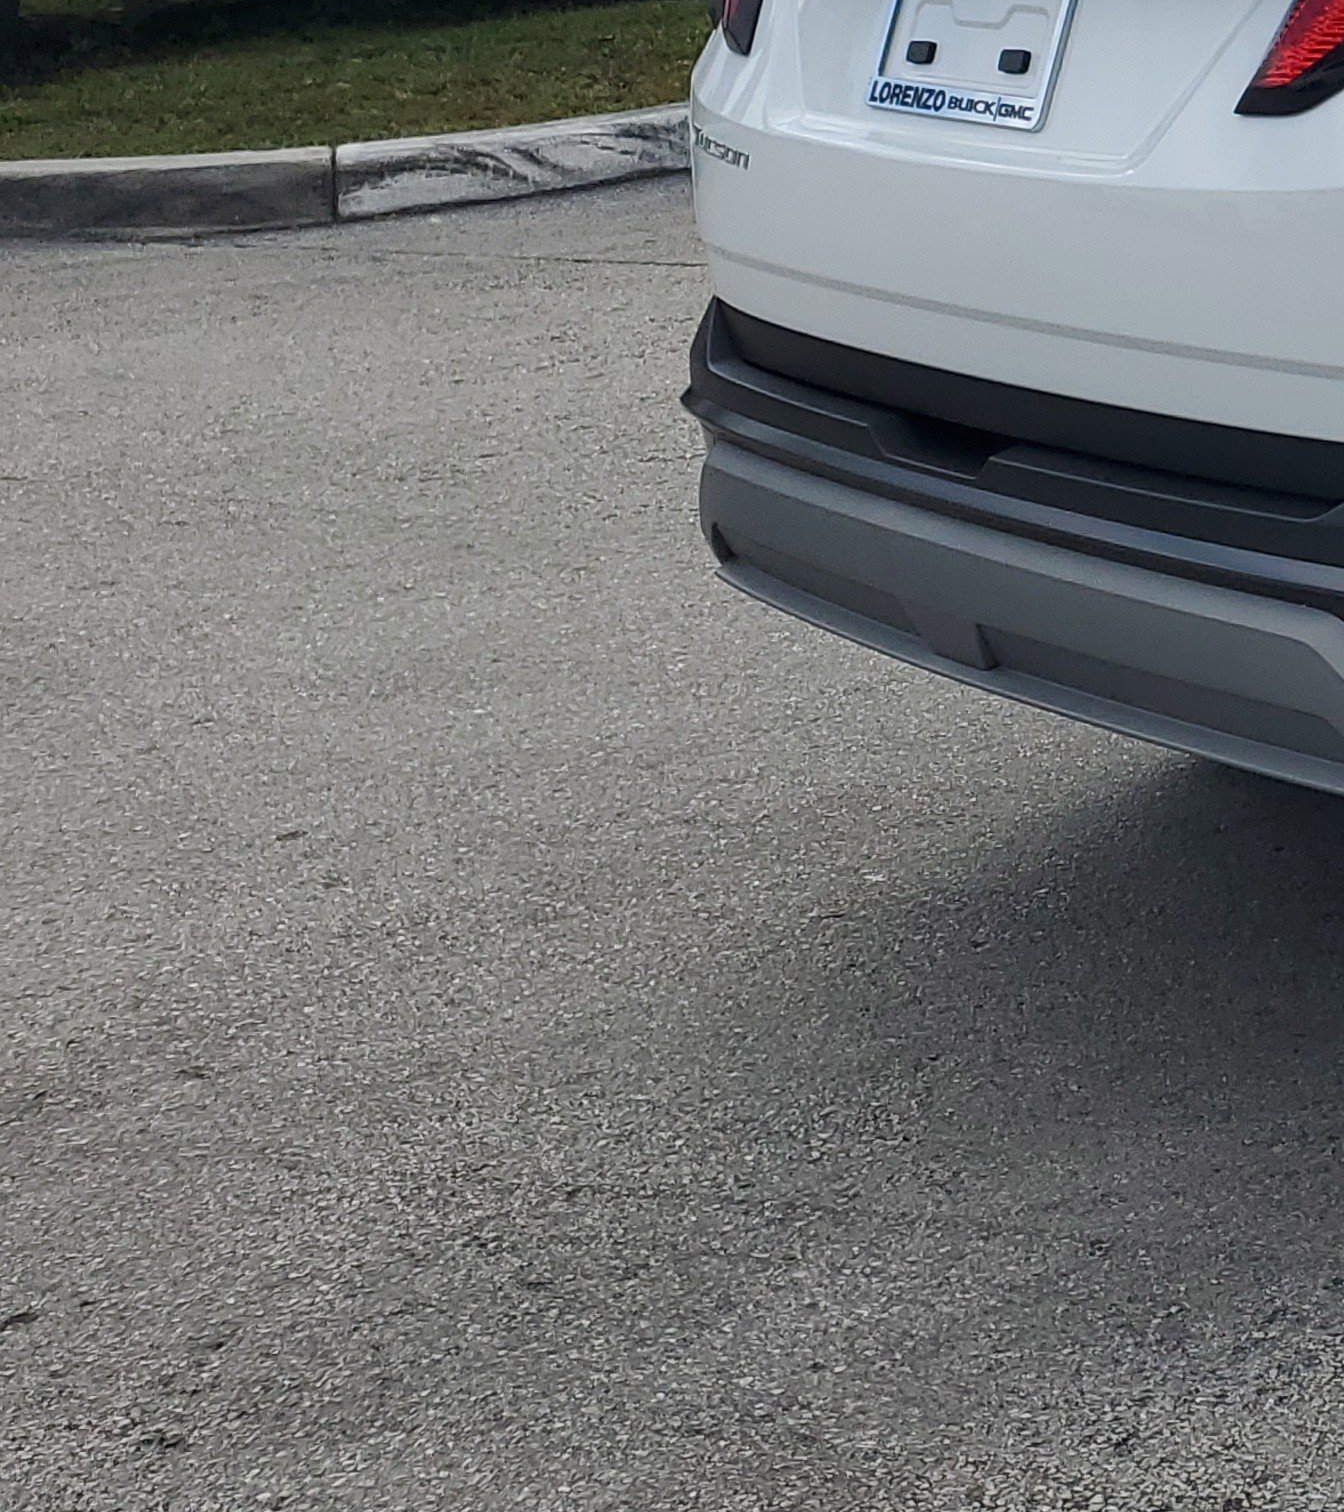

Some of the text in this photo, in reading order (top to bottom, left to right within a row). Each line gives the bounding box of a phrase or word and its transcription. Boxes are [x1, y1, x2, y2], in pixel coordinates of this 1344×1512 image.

[869, 80, 1034, 121] LORENZO BUICK GMC
